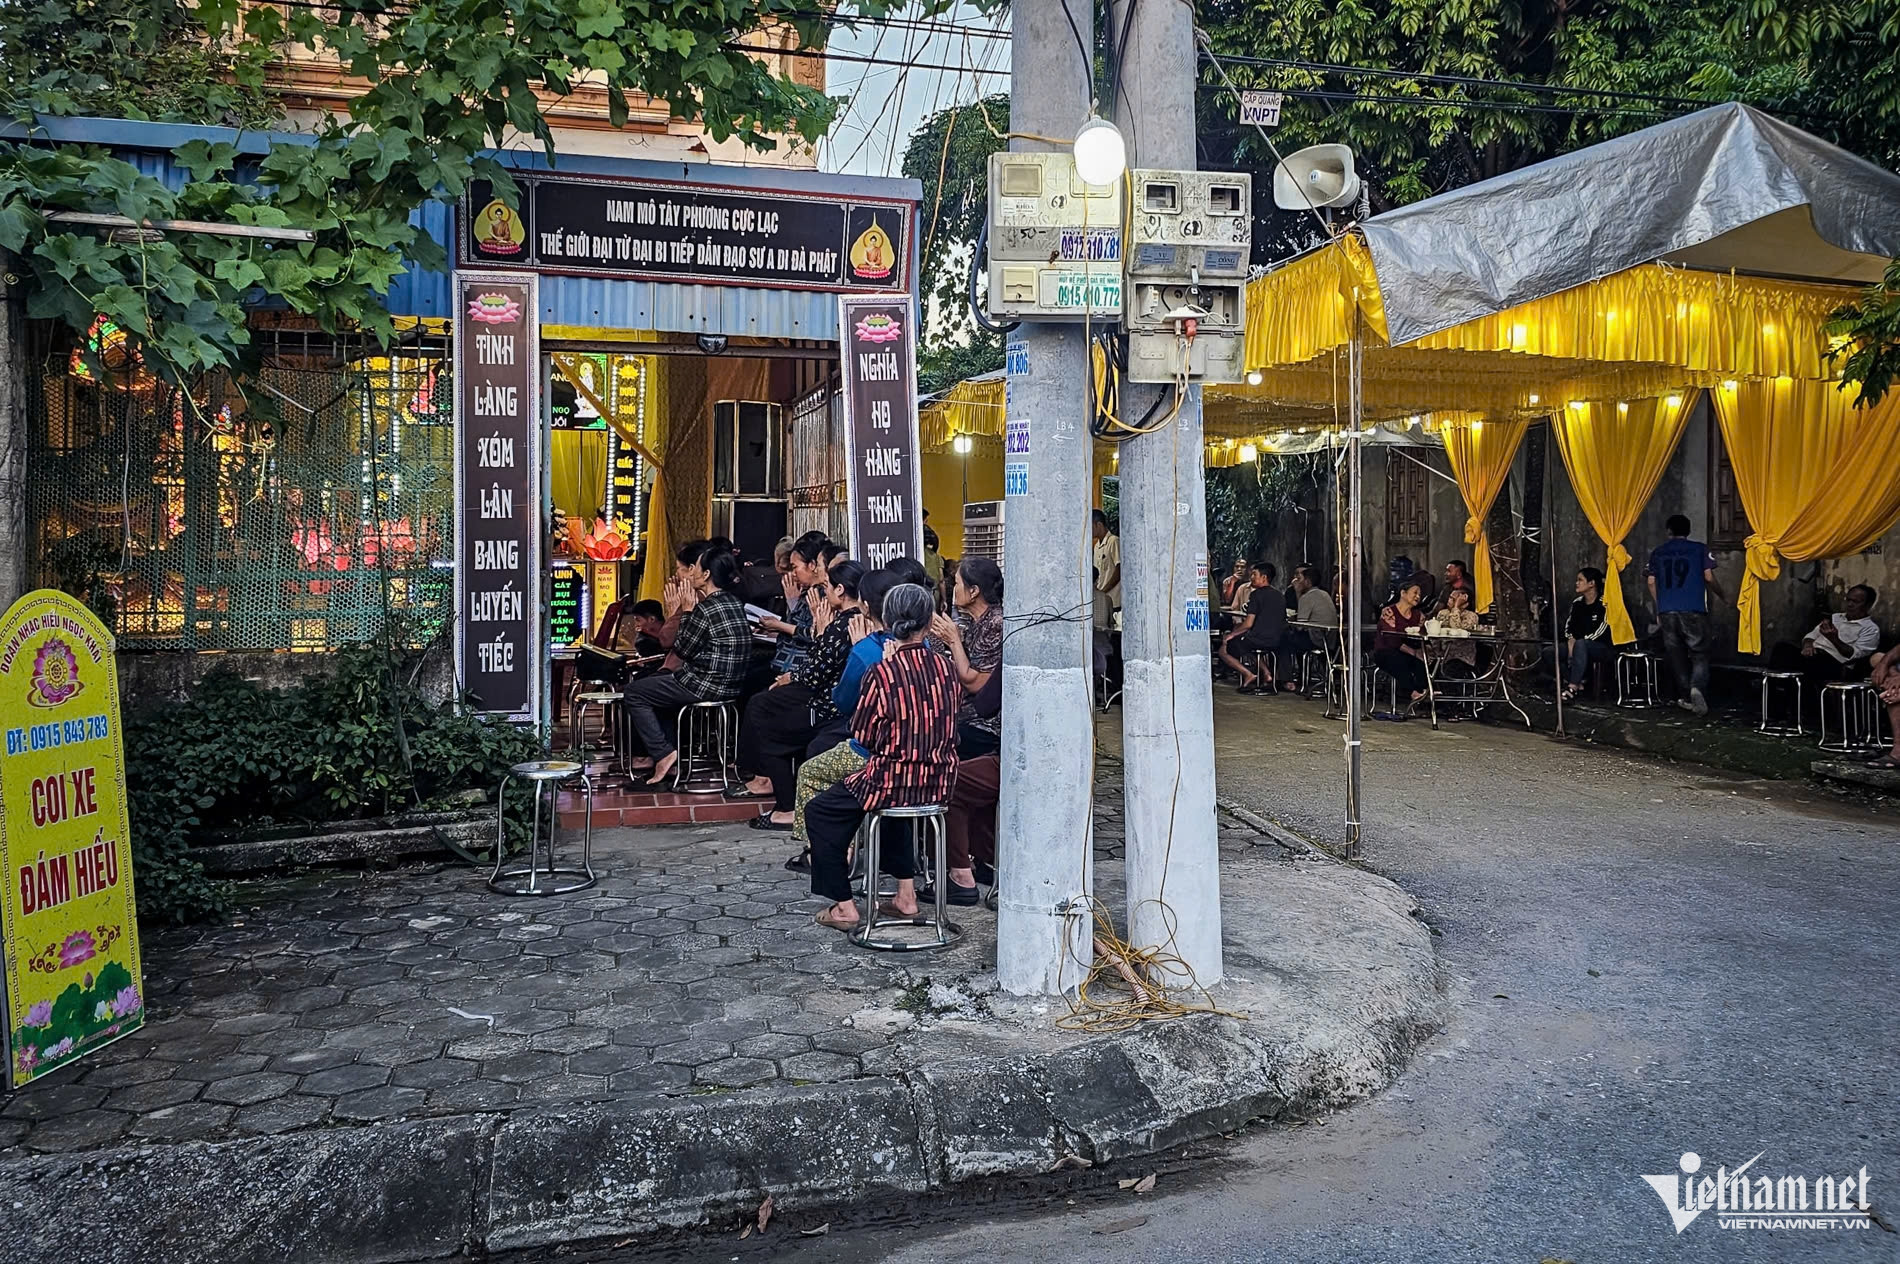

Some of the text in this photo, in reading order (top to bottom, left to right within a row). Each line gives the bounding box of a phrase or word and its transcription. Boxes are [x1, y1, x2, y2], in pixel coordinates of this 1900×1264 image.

[1244, 107, 1278, 122] VNPT
[606, 198, 779, 238] NAM MÔ TÂY PHƯƠNG CỰC LẠC
[540, 227, 838, 278] THẾ GIỚI ĐẠI TỪ ĐẠI BI TIẾP DẪN ĐẠO SƯ A DI ĐÀ PHẬT
[1058, 285, 1120, 307] 0915.410.772
[859, 347, 899, 381] NGHĨA
[871, 400, 891, 434] HỌ
[865, 442, 901, 477] HÀNG
[470, 327, 522, 673] TÌNH LÀNG XÓM LÂN BANG LUYẾN TIẾC
[867, 490, 902, 524] THÂN
[1664, 559, 1689, 589] 19
[17, 617, 41, 642] NHẠC
[62, 617, 84, 640] NGỌC
[7, 715, 108, 756] ĐT: 0915 843 783
[31, 767, 98, 828] COI XE
[20, 826, 118, 916] ĐÁM HIẾU
